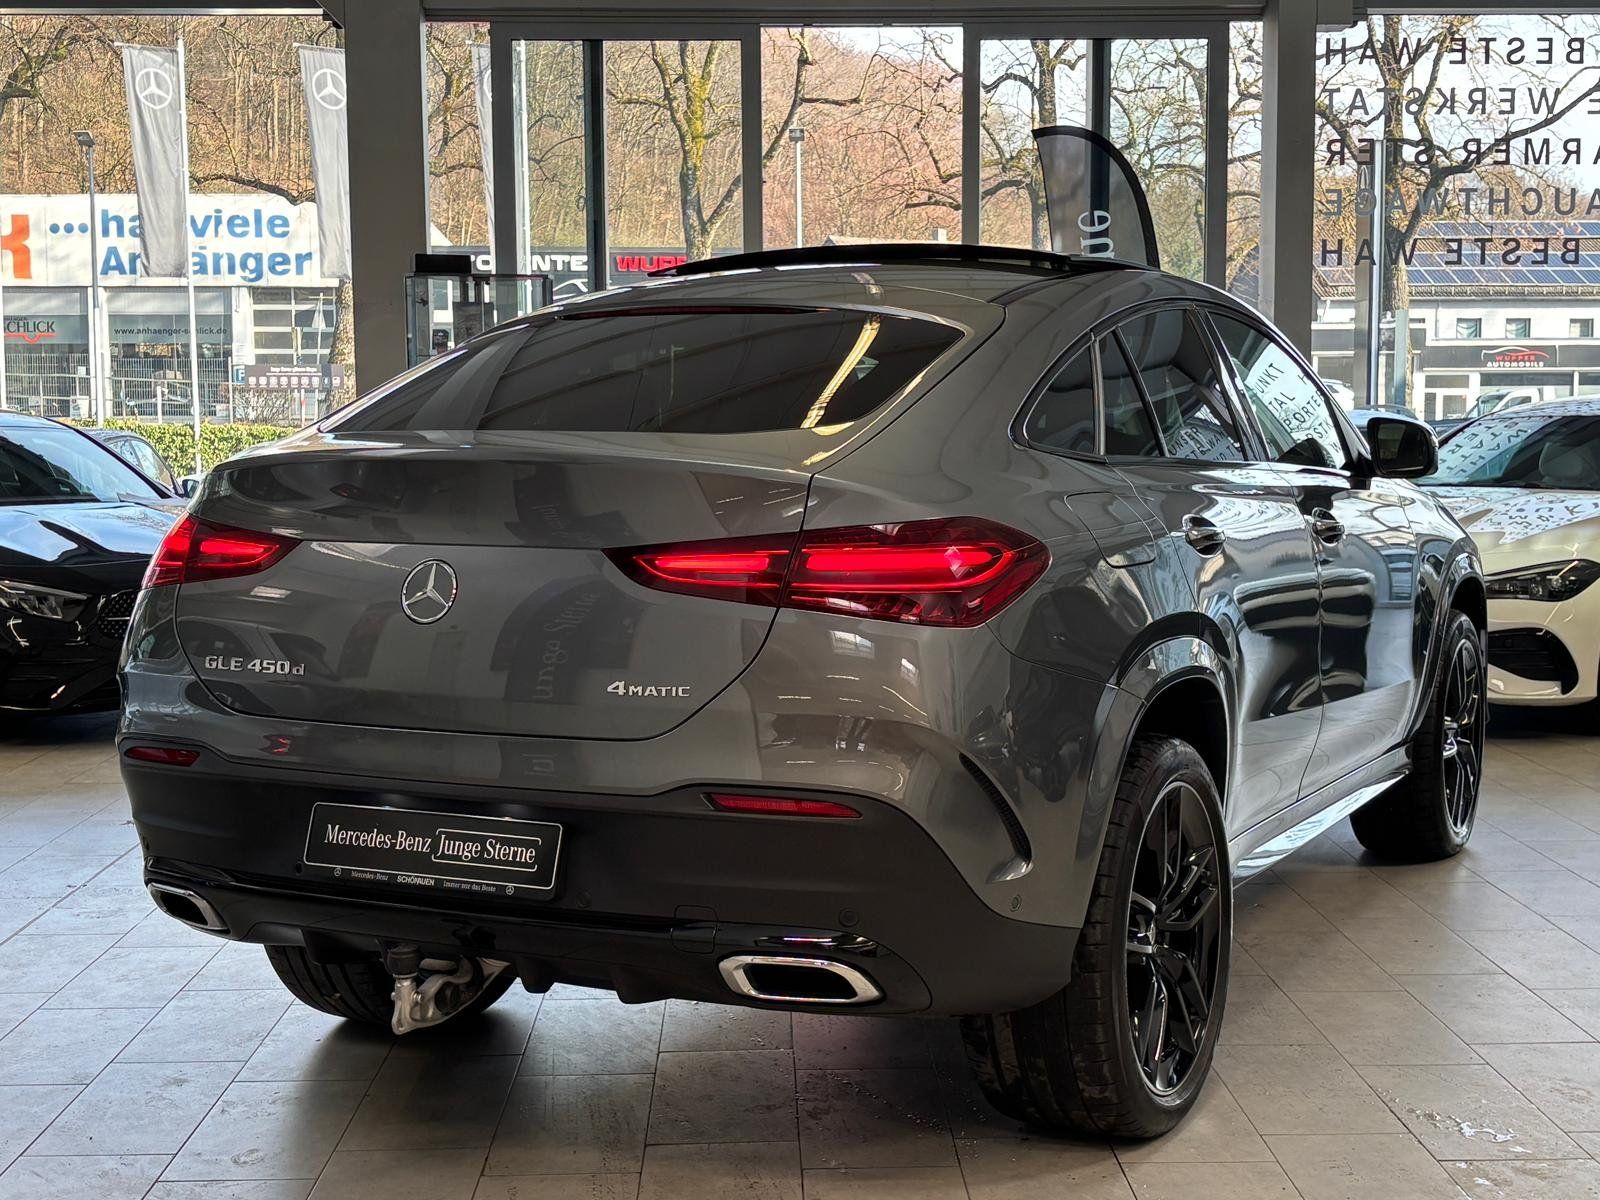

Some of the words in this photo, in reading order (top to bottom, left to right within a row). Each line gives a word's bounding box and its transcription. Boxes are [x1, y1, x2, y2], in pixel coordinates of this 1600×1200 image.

[190, 209, 290, 238] viele
[205, 655, 244, 671] GLE
[606, 680, 690, 697] 4MATIC
[324, 823, 432, 853] Mercedes-Benz
[436, 834, 481, 861] Junge
[484, 838, 536, 864] Sterne
